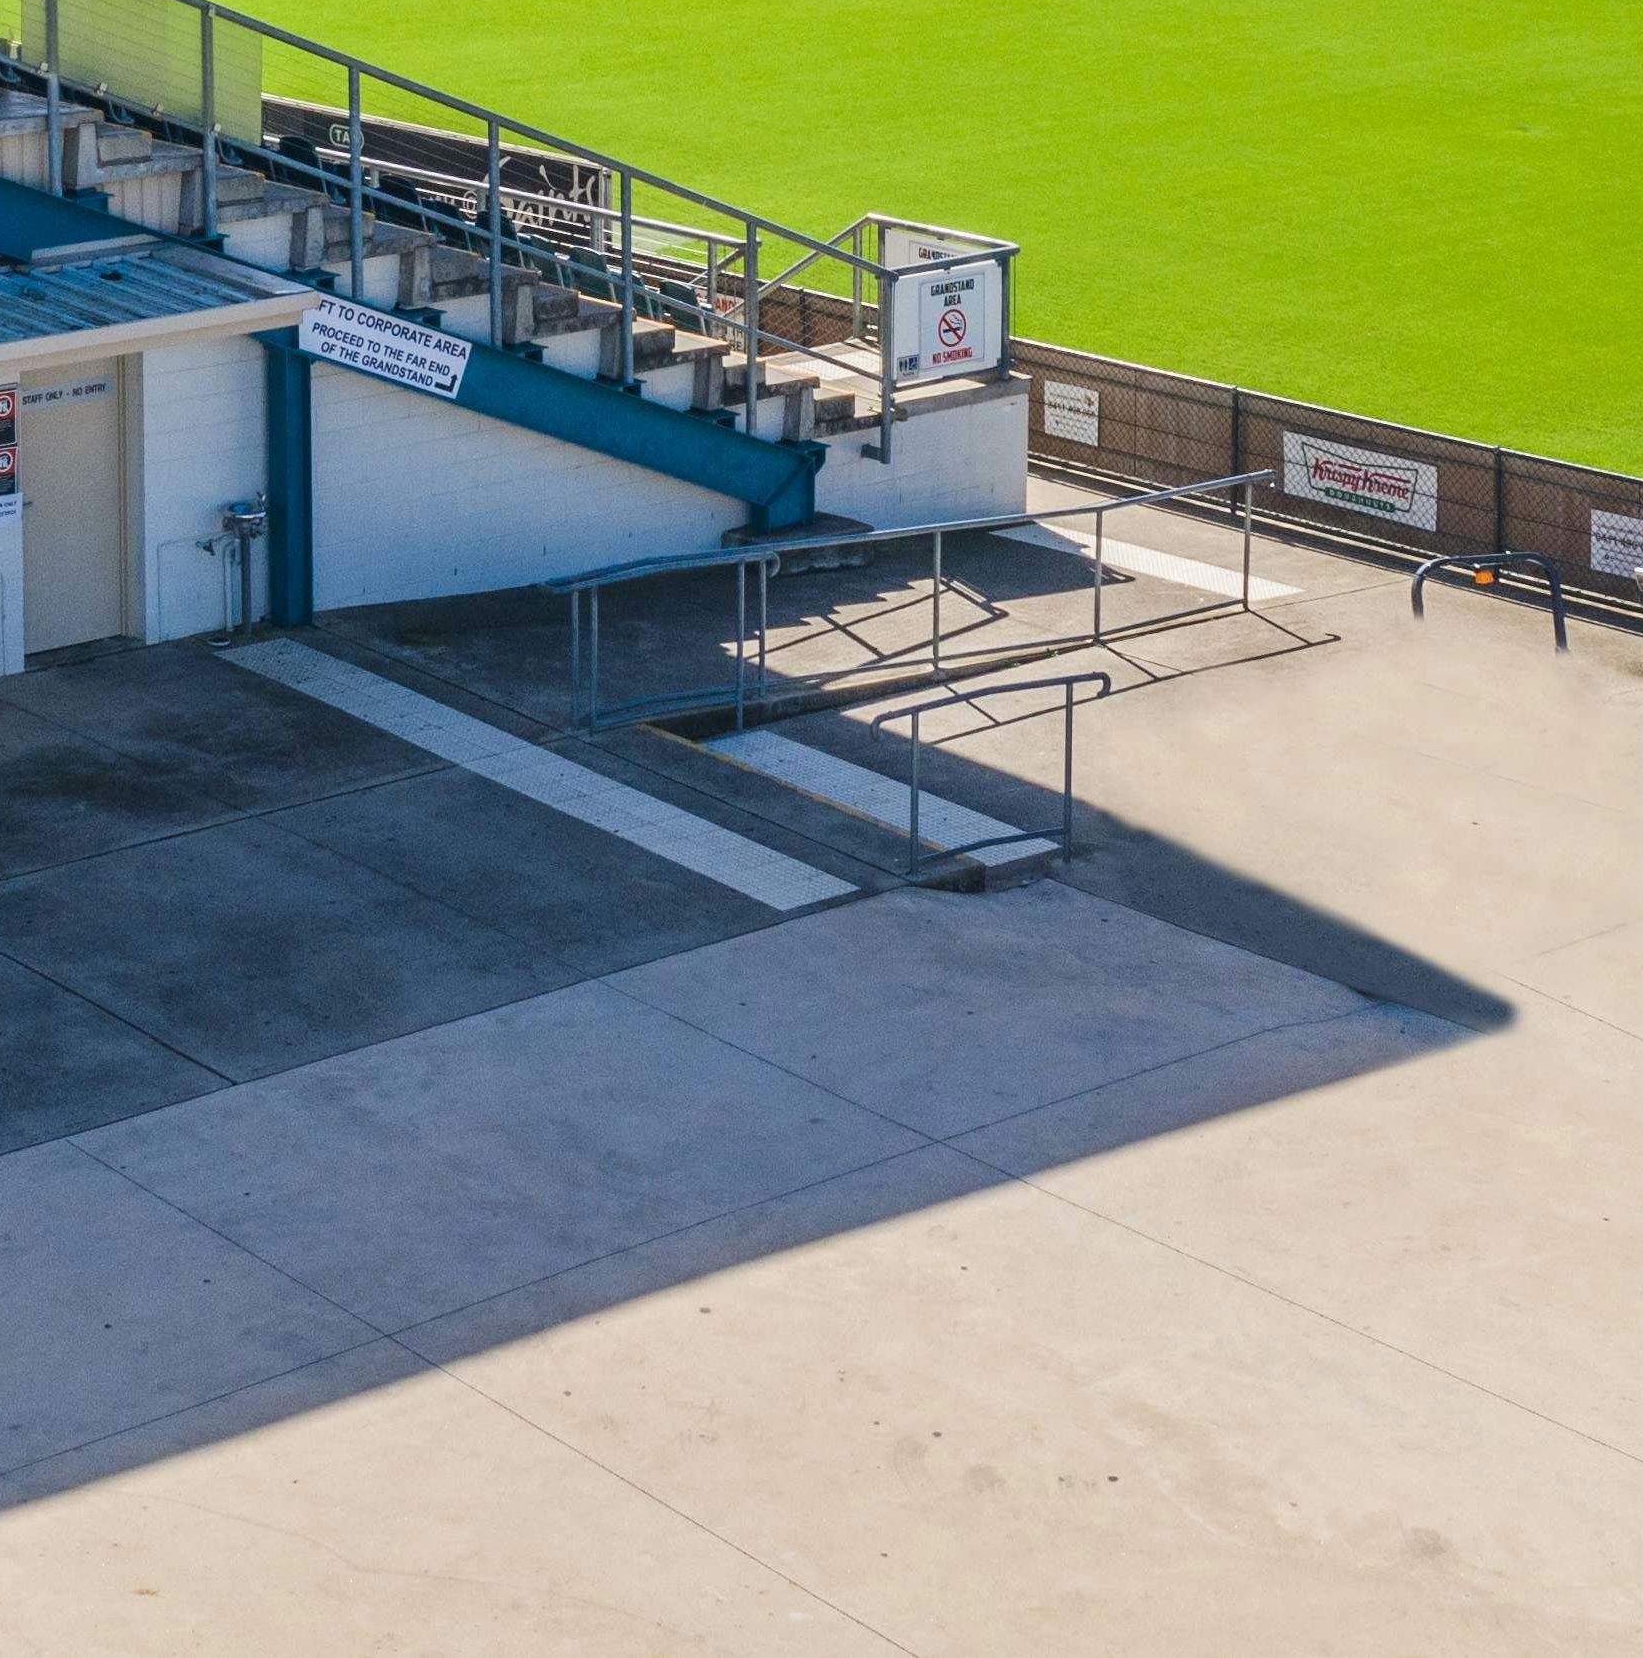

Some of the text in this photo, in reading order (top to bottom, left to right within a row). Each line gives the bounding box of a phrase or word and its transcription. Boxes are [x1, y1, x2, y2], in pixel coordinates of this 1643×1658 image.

[334, 128, 351, 143] TA
[930, 278, 975, 296] GRANDSTAND
[943, 294, 962, 307] AREA
[319, 299, 467, 360] FT TO CORPORATE AREA
[312, 321, 451, 377] PROCEED TO THE FAR END
[932, 347, 973, 365] NO SMOKING
[320, 341, 434, 387] OF THE GRANDSTAND
[22, 393, 44, 406] STAFF
[1312, 456, 1412, 500] Krispy Kreme
